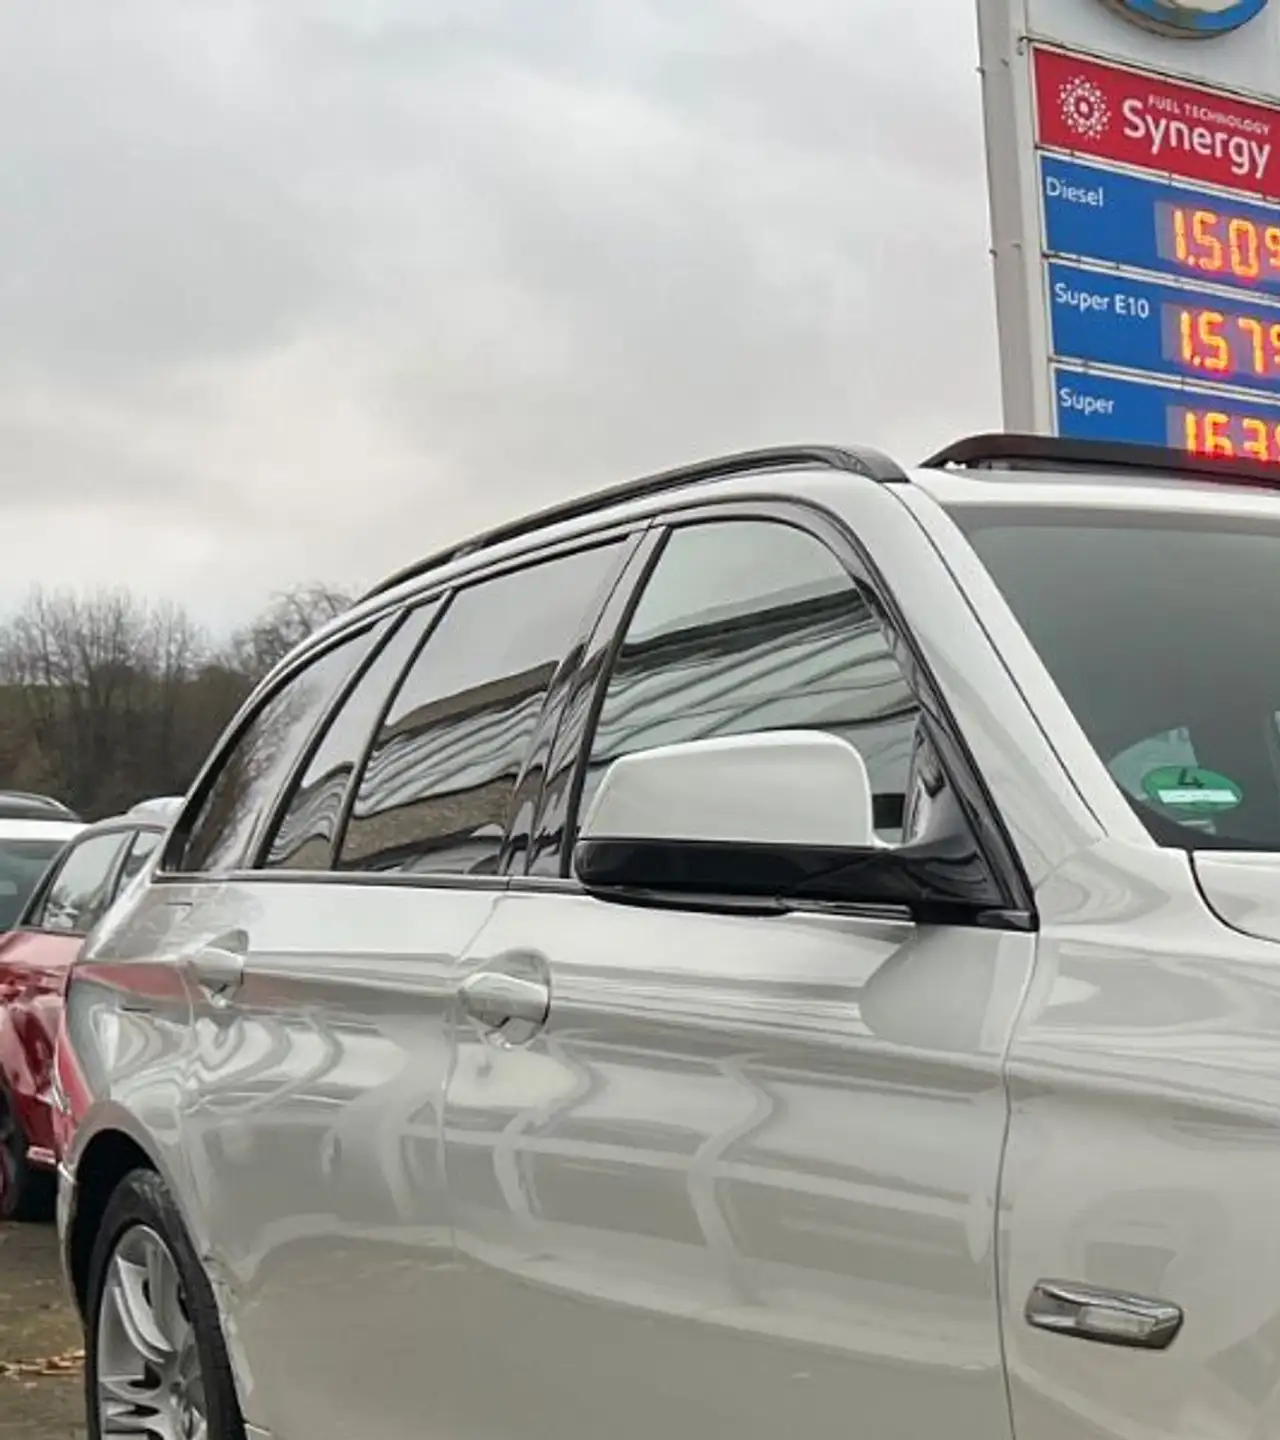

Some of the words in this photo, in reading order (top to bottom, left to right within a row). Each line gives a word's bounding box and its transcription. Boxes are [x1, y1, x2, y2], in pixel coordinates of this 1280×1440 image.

[1147, 93, 1180, 116] FUEL
[1183, 104, 1272, 137] TECHNOLOGY
[1121, 97, 1272, 180] Synergy
[1045, 176, 1104, 208] Diesel
[1054, 282, 1108, 313] Super
[1115, 293, 1151, 319] E10
[1059, 386, 1115, 416] Super
